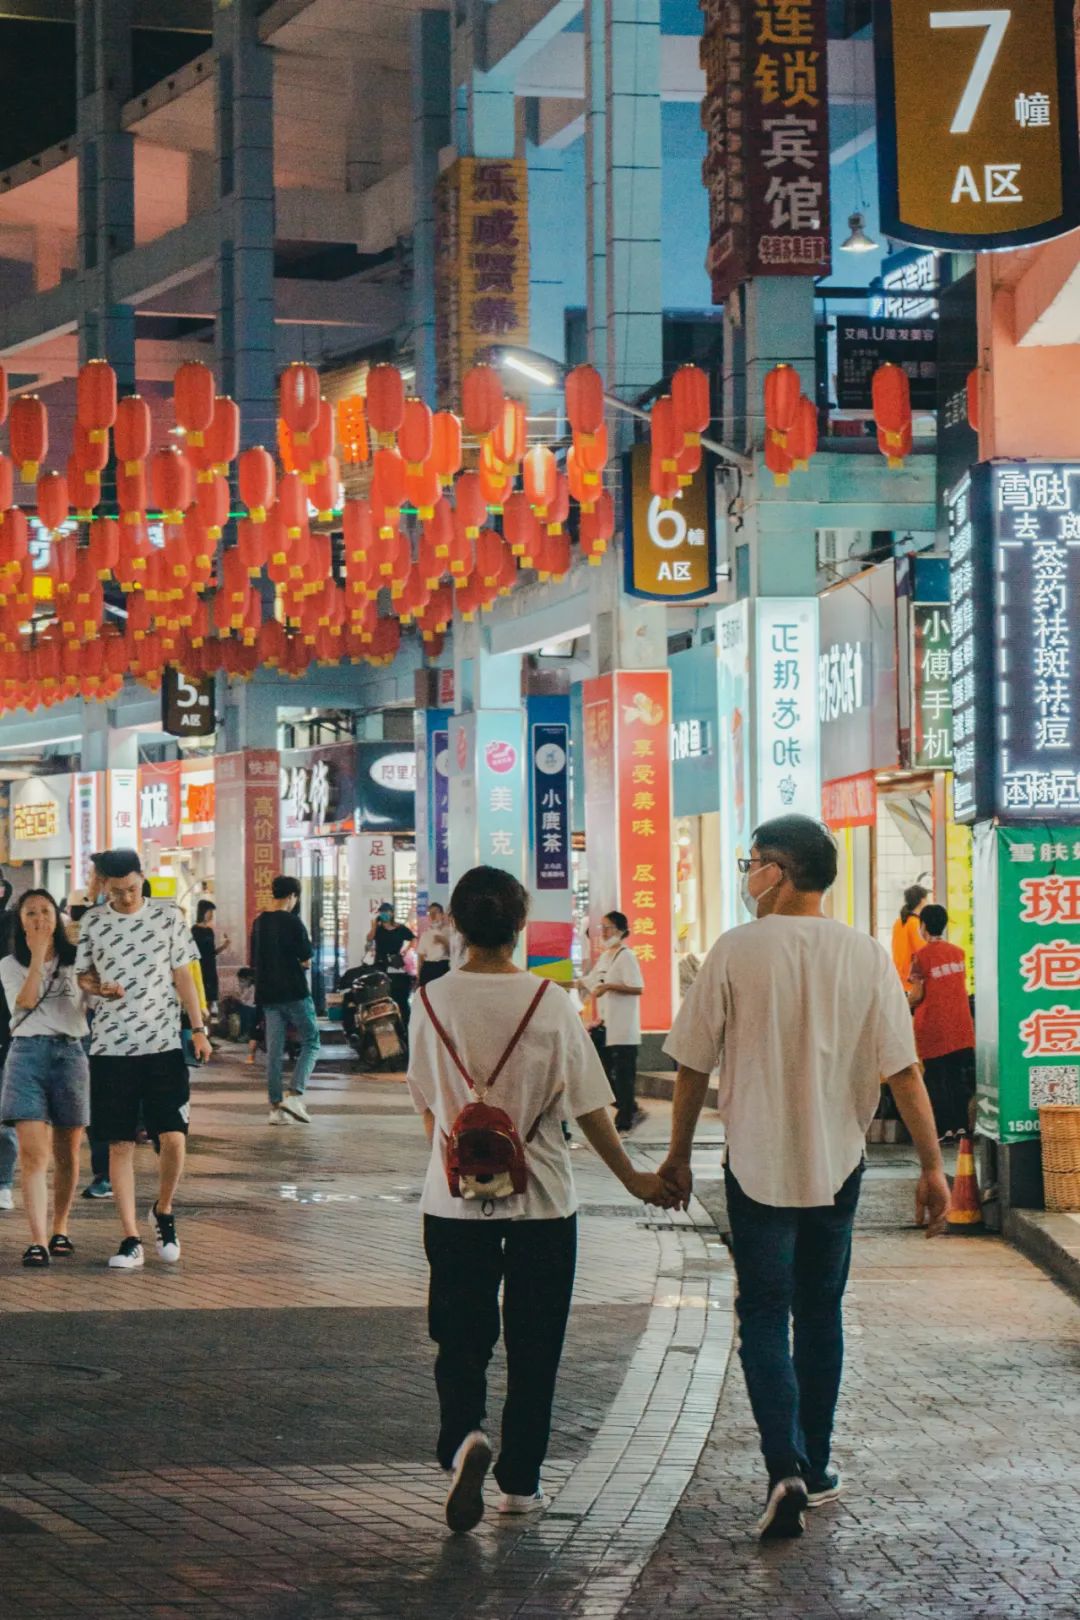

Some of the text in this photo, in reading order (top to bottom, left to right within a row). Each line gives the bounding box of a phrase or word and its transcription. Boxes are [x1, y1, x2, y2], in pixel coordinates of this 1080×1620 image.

[950, 164, 1023, 204] A区
[658, 561, 692, 581] A区
[921, 611, 952, 760] 小傅手机
[541, 788, 562, 853] 小鹿茶
